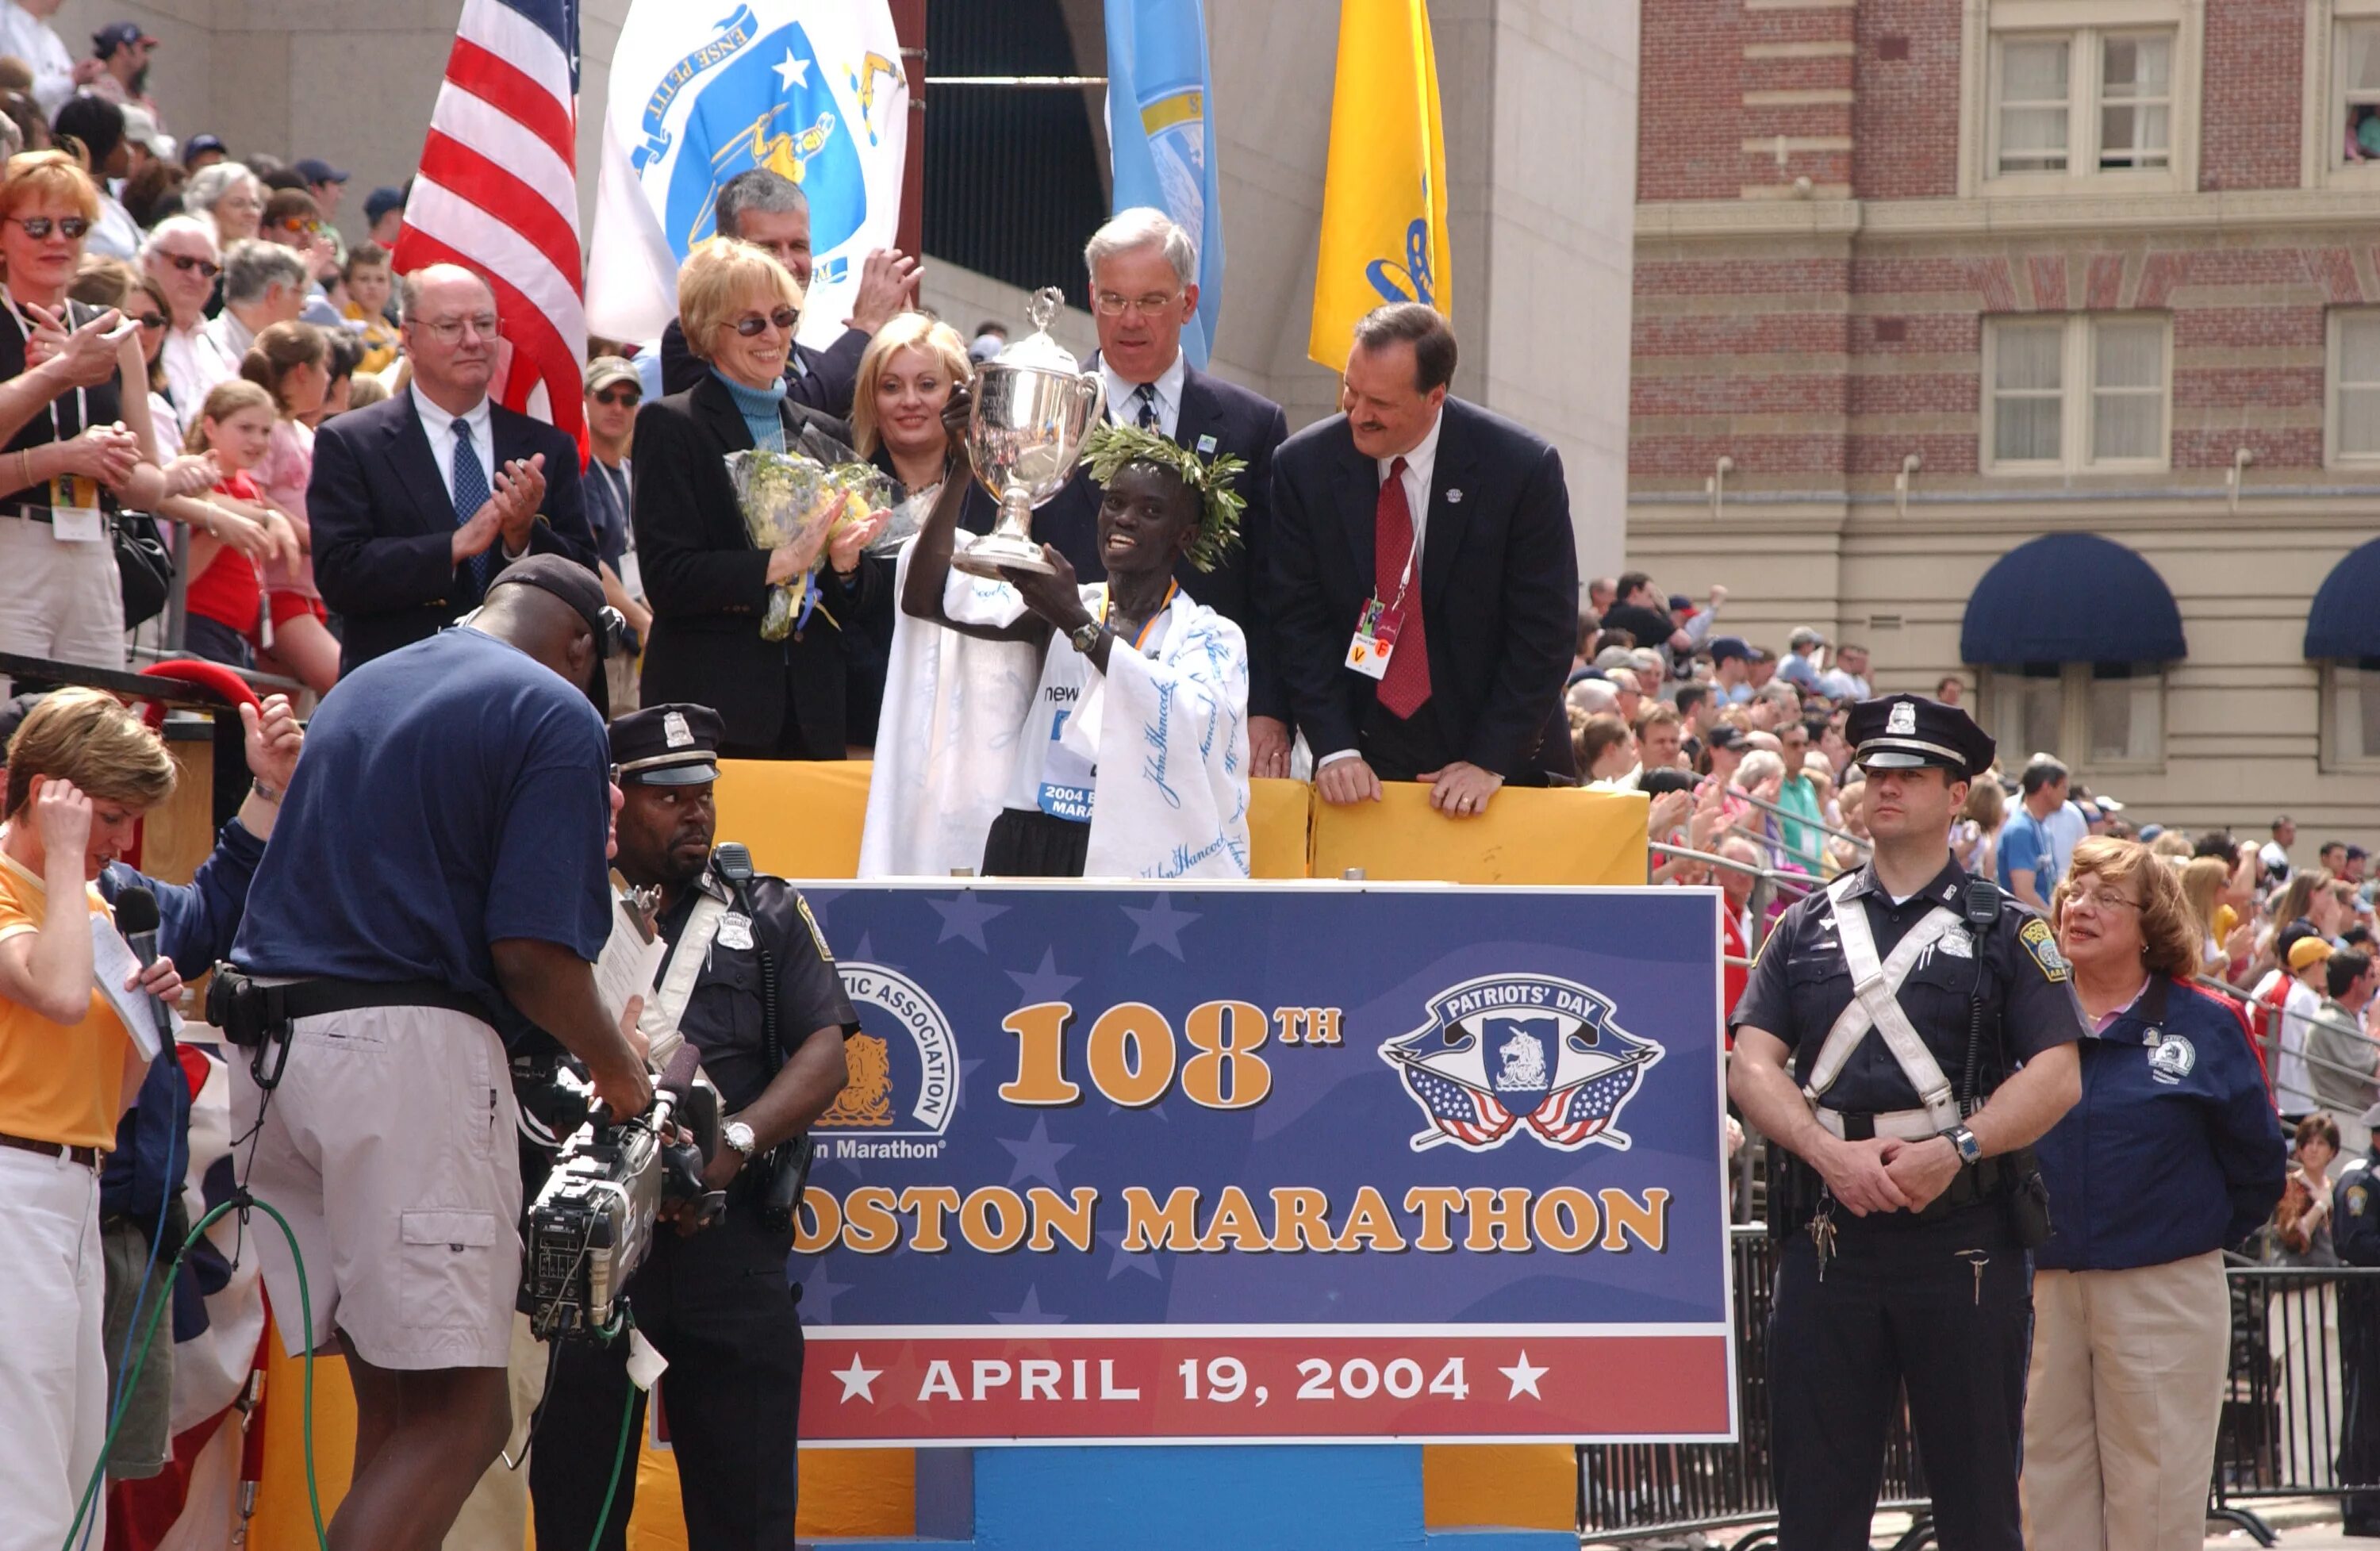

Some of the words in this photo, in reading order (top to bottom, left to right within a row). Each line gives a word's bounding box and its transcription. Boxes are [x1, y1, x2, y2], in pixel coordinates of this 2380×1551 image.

[694, 26, 748, 68] ENSE
[648, 57, 693, 121] PETIT
[1353, 647, 1365, 662] V
[1376, 643, 1388, 656] F
[1045, 686, 1080, 702] new
[1045, 786, 1084, 801] 2004
[1446, 985, 1550, 1019] PATRIOTS'
[1556, 990, 1599, 1018] DAY
[876, 984, 946, 1115] ASSOCIATION
[793, 1186, 1102, 1253] OSTON
[1121, 1186, 1673, 1253] MARATHON
[917, 1359, 1140, 1401] APRIL
[1179, 1356, 1269, 1407] 19,
[1296, 1356, 1469, 1403] 2004
